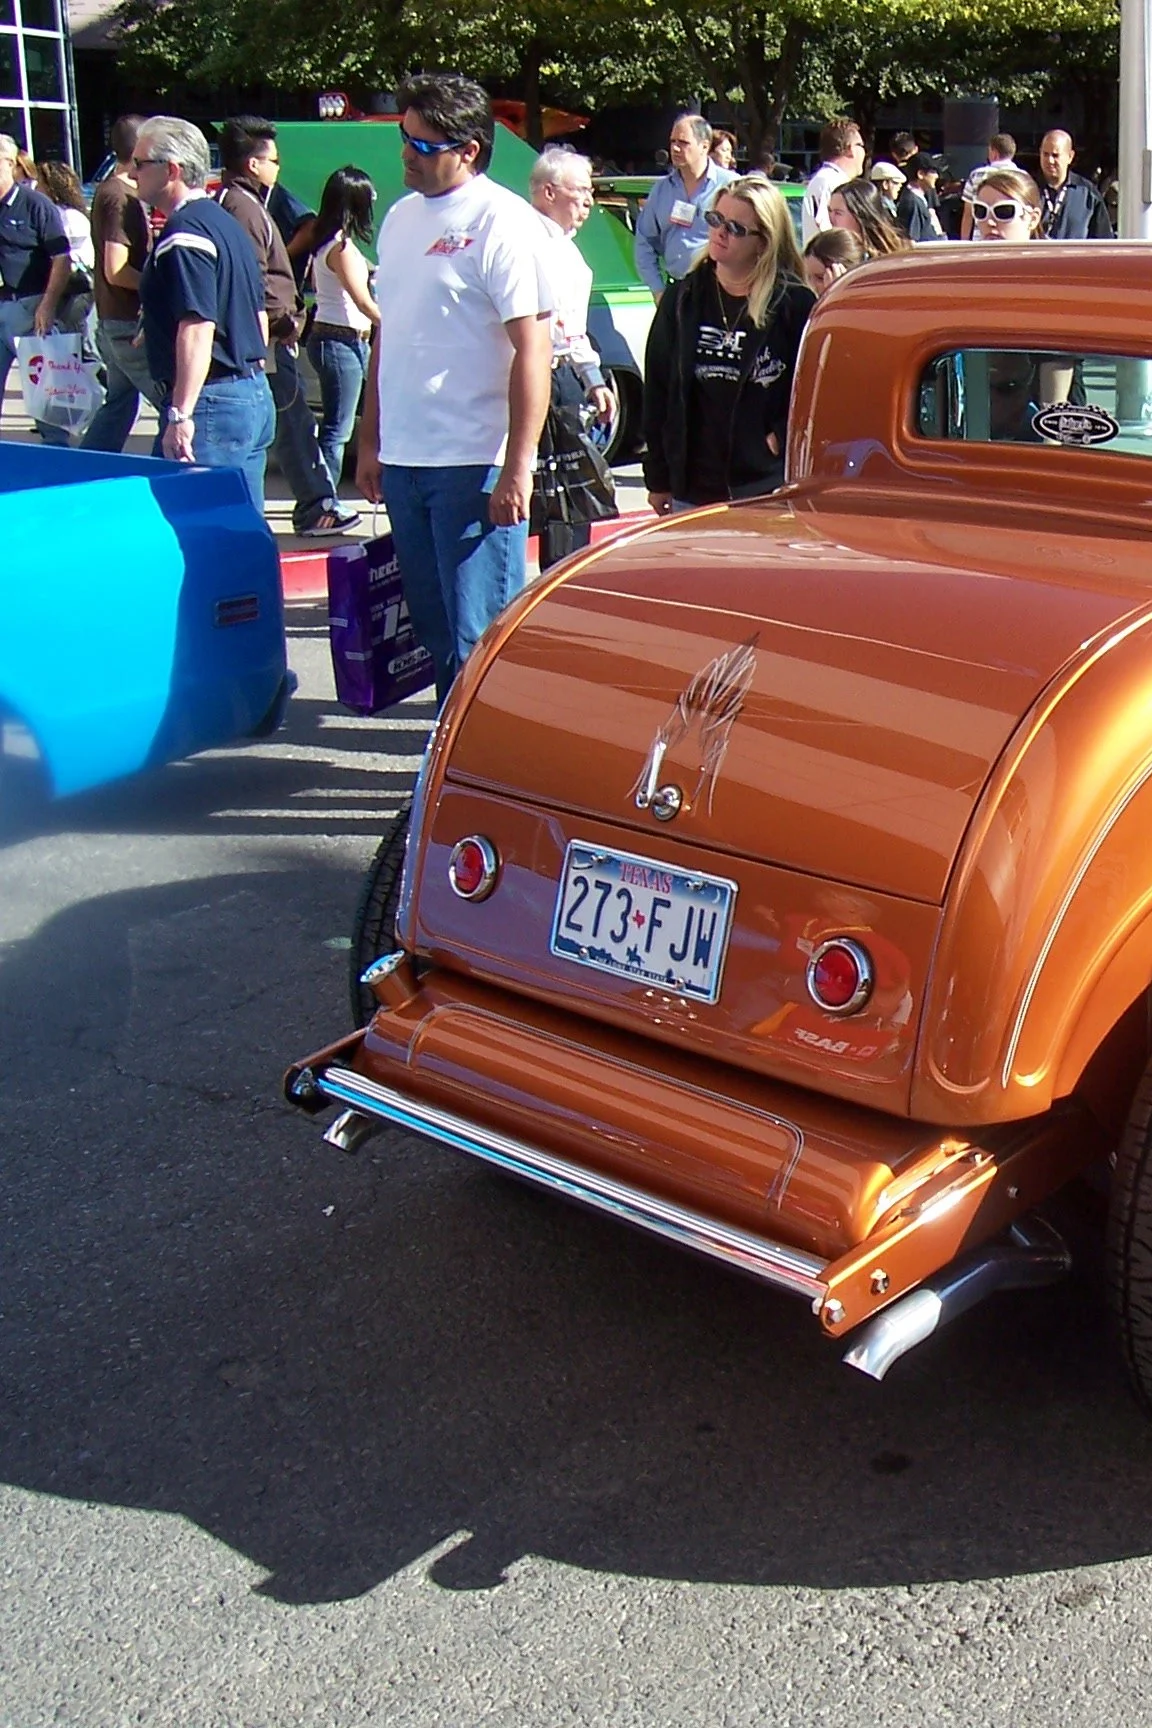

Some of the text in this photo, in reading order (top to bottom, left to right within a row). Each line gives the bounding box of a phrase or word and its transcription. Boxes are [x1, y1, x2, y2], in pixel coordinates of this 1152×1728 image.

[620, 863, 672, 894] TEXAS
[565, 876, 717, 968] 273 FJW
